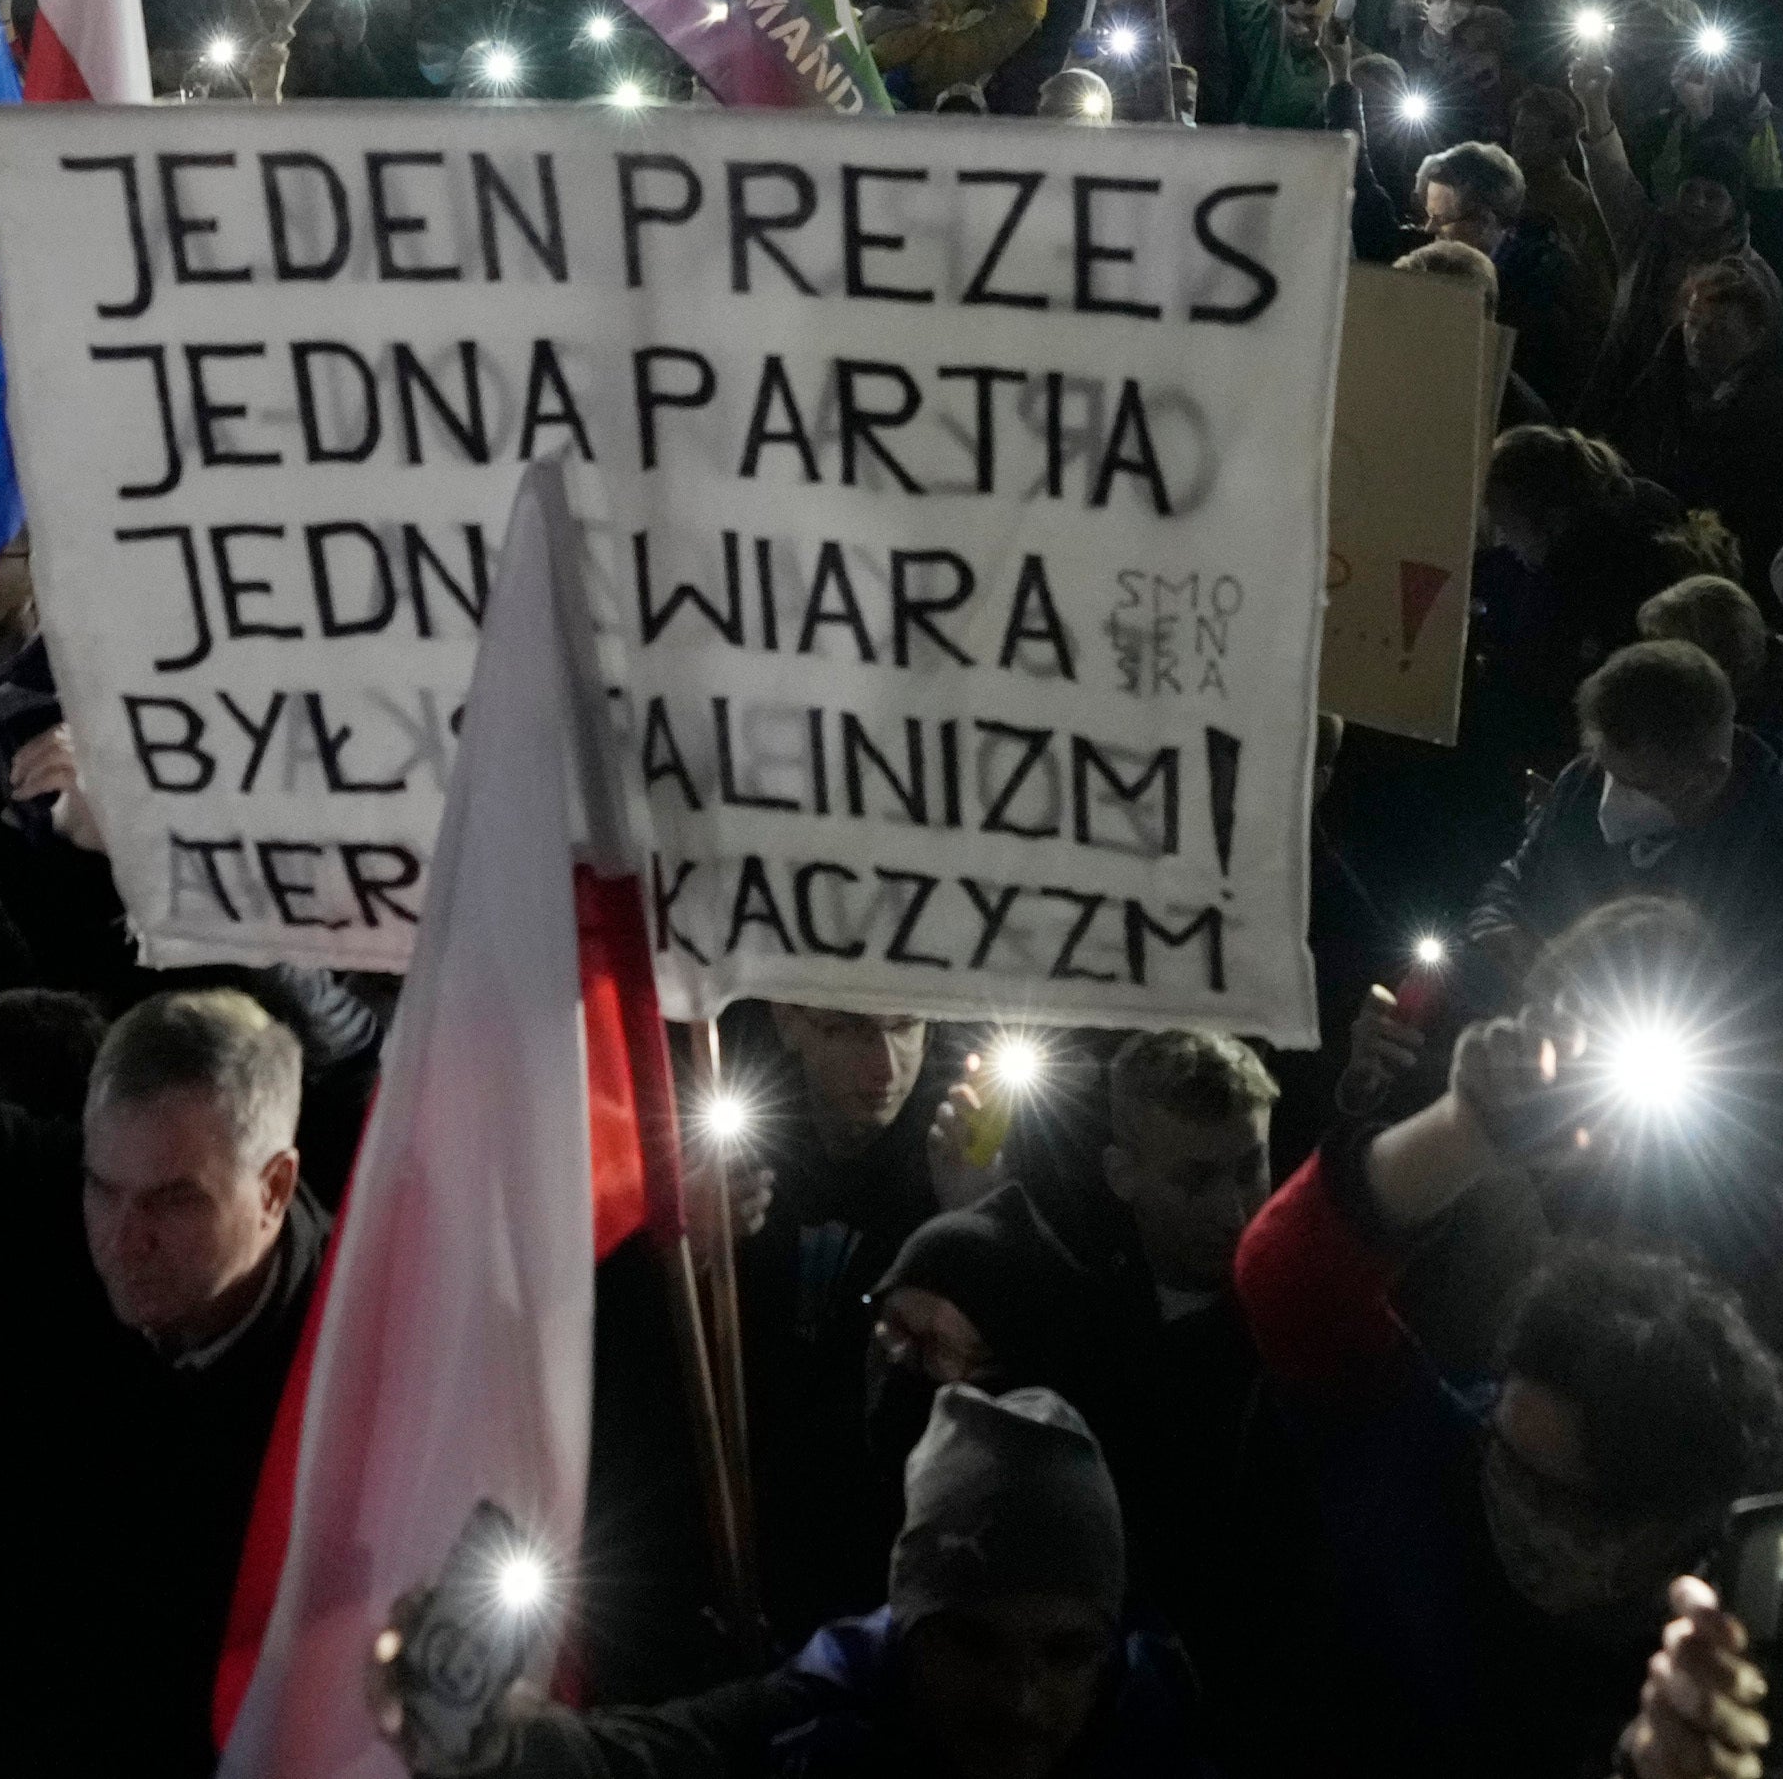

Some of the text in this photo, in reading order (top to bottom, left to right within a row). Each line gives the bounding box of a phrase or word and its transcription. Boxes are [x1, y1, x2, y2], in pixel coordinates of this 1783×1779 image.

[59, 152, 1279, 323] JEDEN PREZES
[88, 338, 1173, 518] JEDNA PARTIA
[114, 520, 1076, 684] JEDN WIARA
[1117, 569, 1244, 617] SMO
[121, 690, 406, 794] BYŁ
[168, 832, 1226, 993] TER KACZYZM
